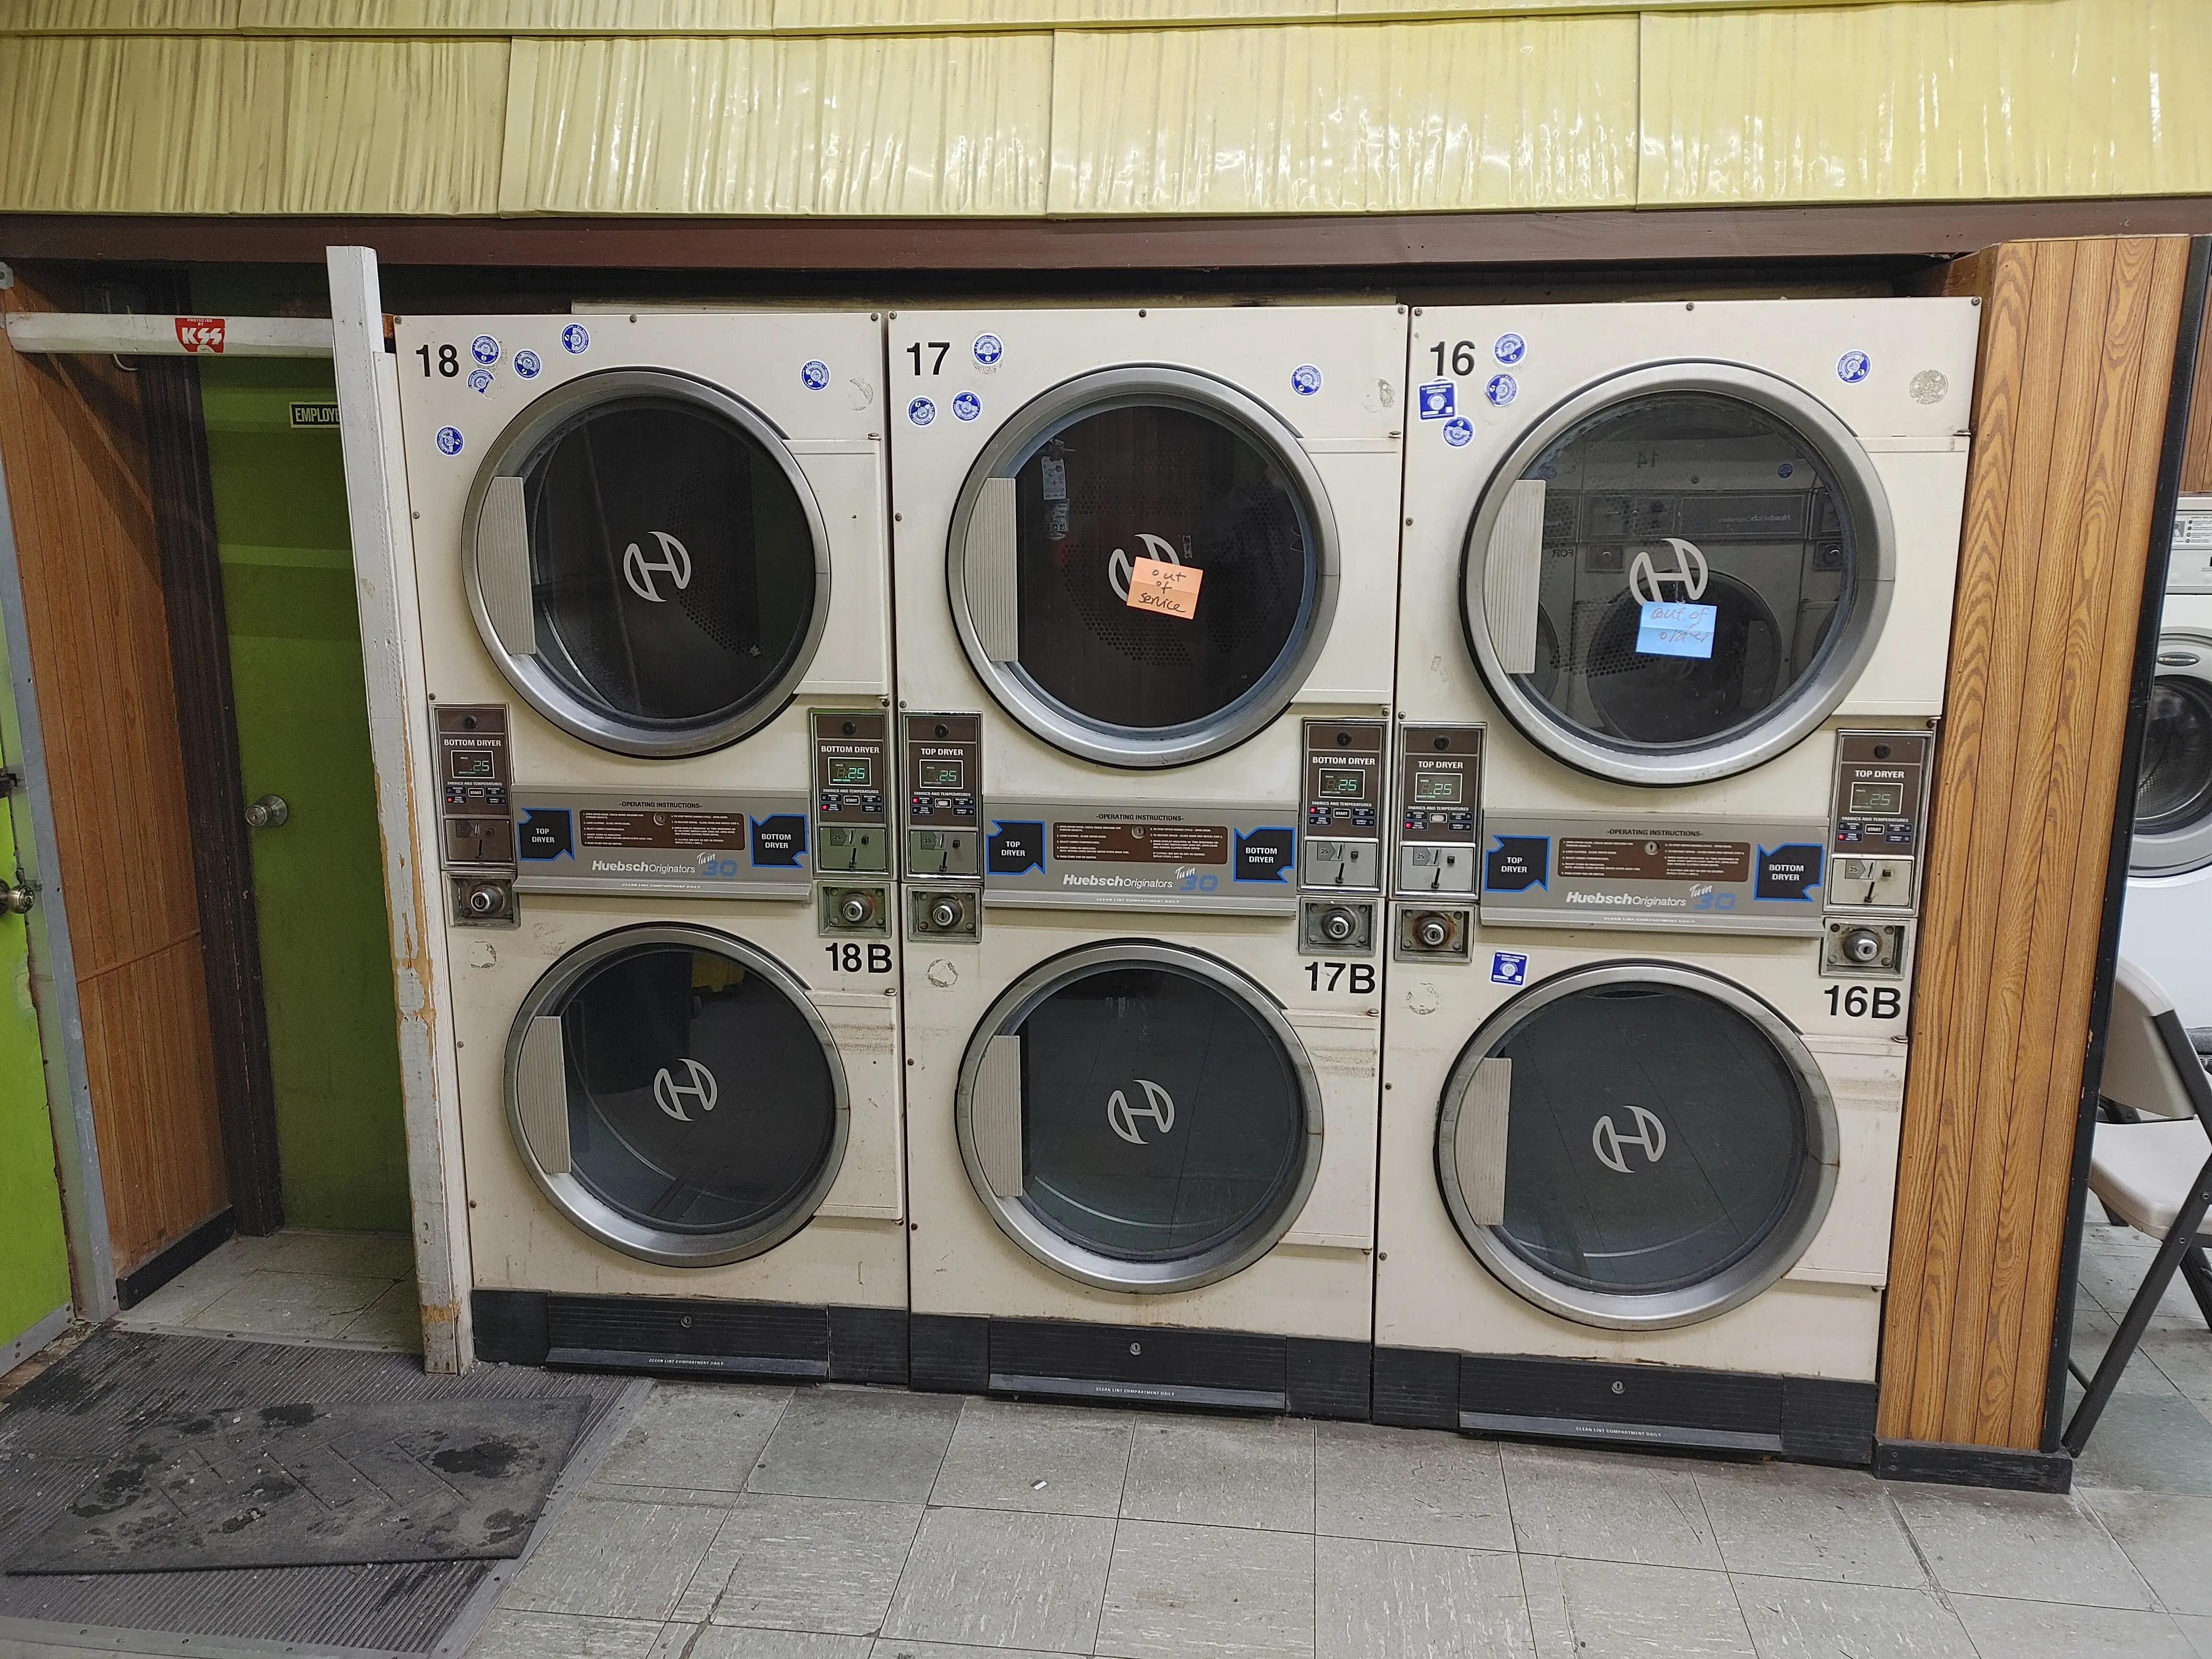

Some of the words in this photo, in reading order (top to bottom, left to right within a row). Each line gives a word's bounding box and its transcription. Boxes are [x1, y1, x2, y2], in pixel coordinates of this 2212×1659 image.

[182, 327, 222, 344] KSS
[416, 344, 459, 377] 18
[906, 342, 950, 376] 17
[1430, 341, 1475, 376] 16
[1152, 570, 1186, 582] out
[1156, 581, 1172, 594] of
[1139, 593, 1185, 612] service
[1689, 607, 1709, 625] of
[697, 852, 716, 865] Twin
[1001, 849, 1025, 857] DRYER
[1249, 855, 1274, 863] DRYER
[702, 859, 738, 877] 30
[1175, 866, 1195, 880] Twin
[1501, 865, 1527, 874] DRYER
[1769, 864, 1804, 872] BOTTOM
[1180, 874, 1218, 892] 30
[1772, 873, 1799, 881] DRYER
[1690, 884, 1713, 898] Twin
[1693, 893, 1736, 910] 30
[825, 942, 892, 973] 18B
[1305, 962, 1375, 994] 17B
[1825, 985, 1901, 1019] 16B
